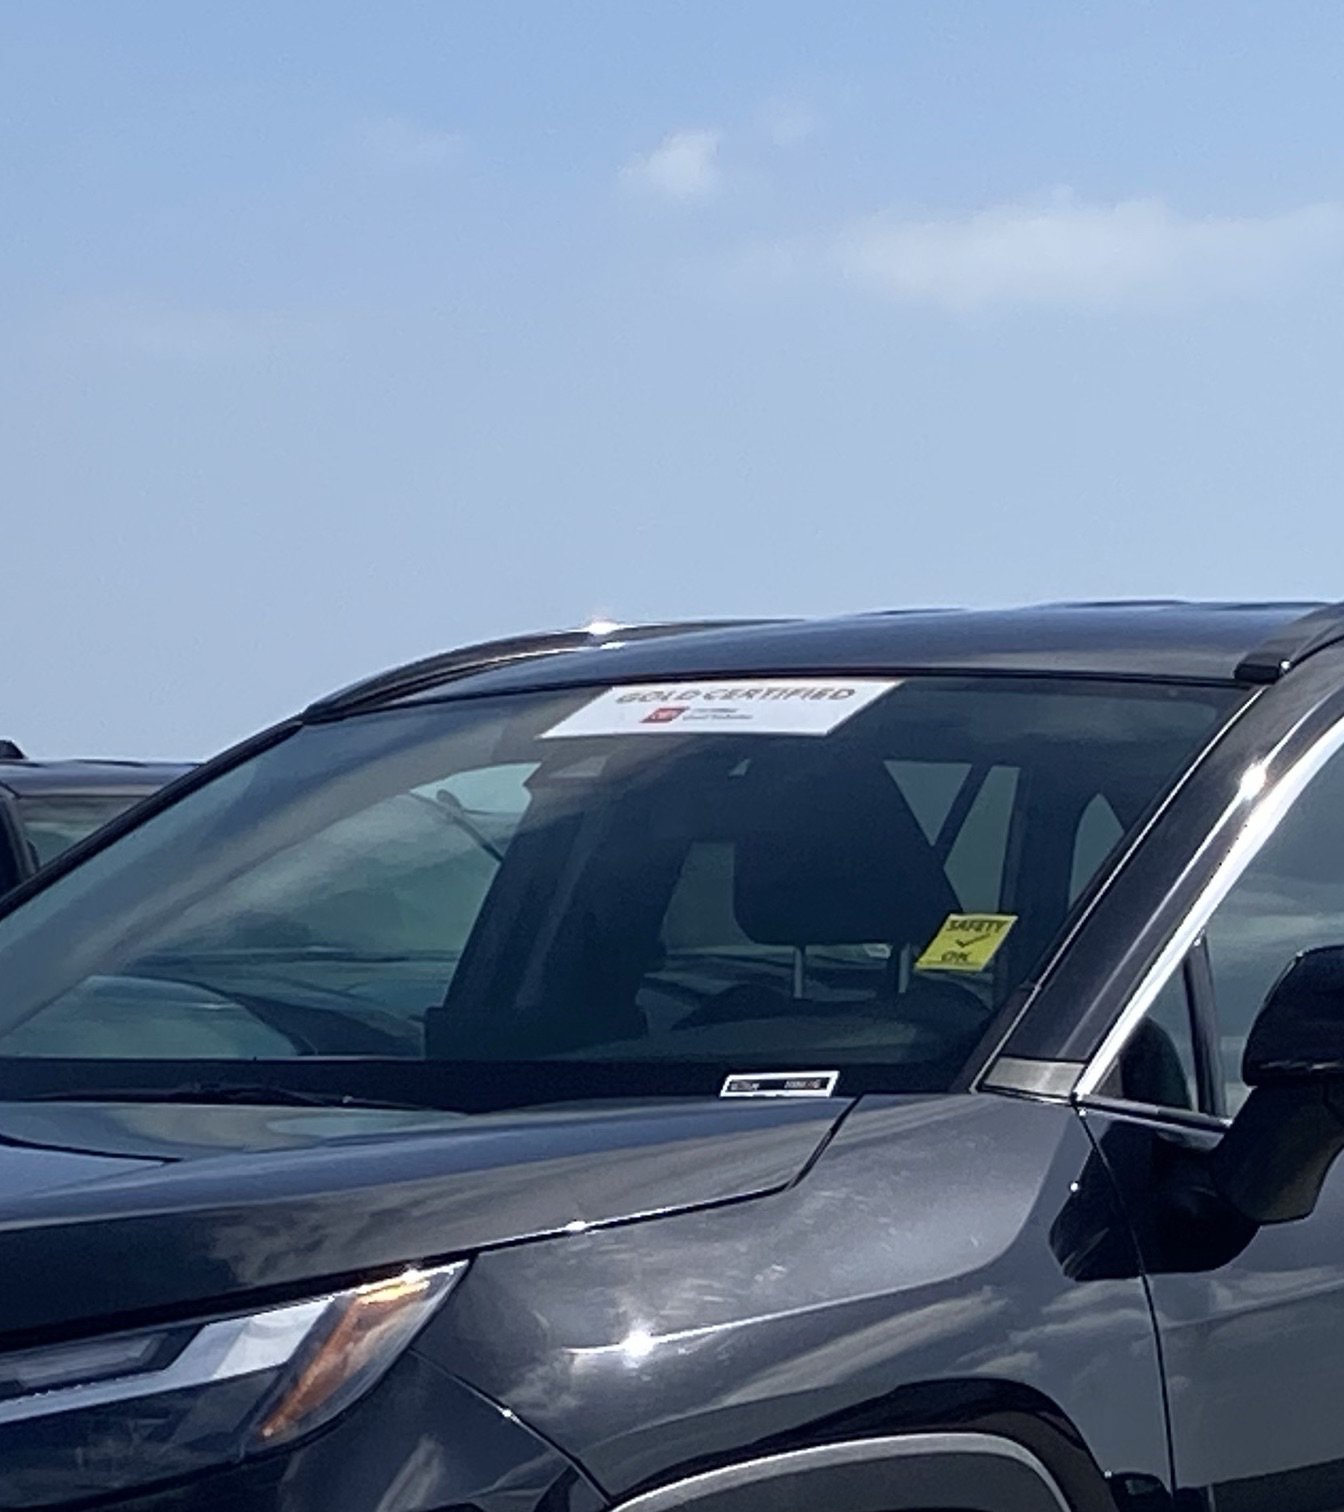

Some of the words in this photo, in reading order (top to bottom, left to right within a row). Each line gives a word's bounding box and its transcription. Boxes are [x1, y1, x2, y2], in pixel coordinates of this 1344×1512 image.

[705, 687, 856, 702] CERTIFIED
[946, 920, 1008, 933] SAFETY
[941, 951, 970, 962] OK
